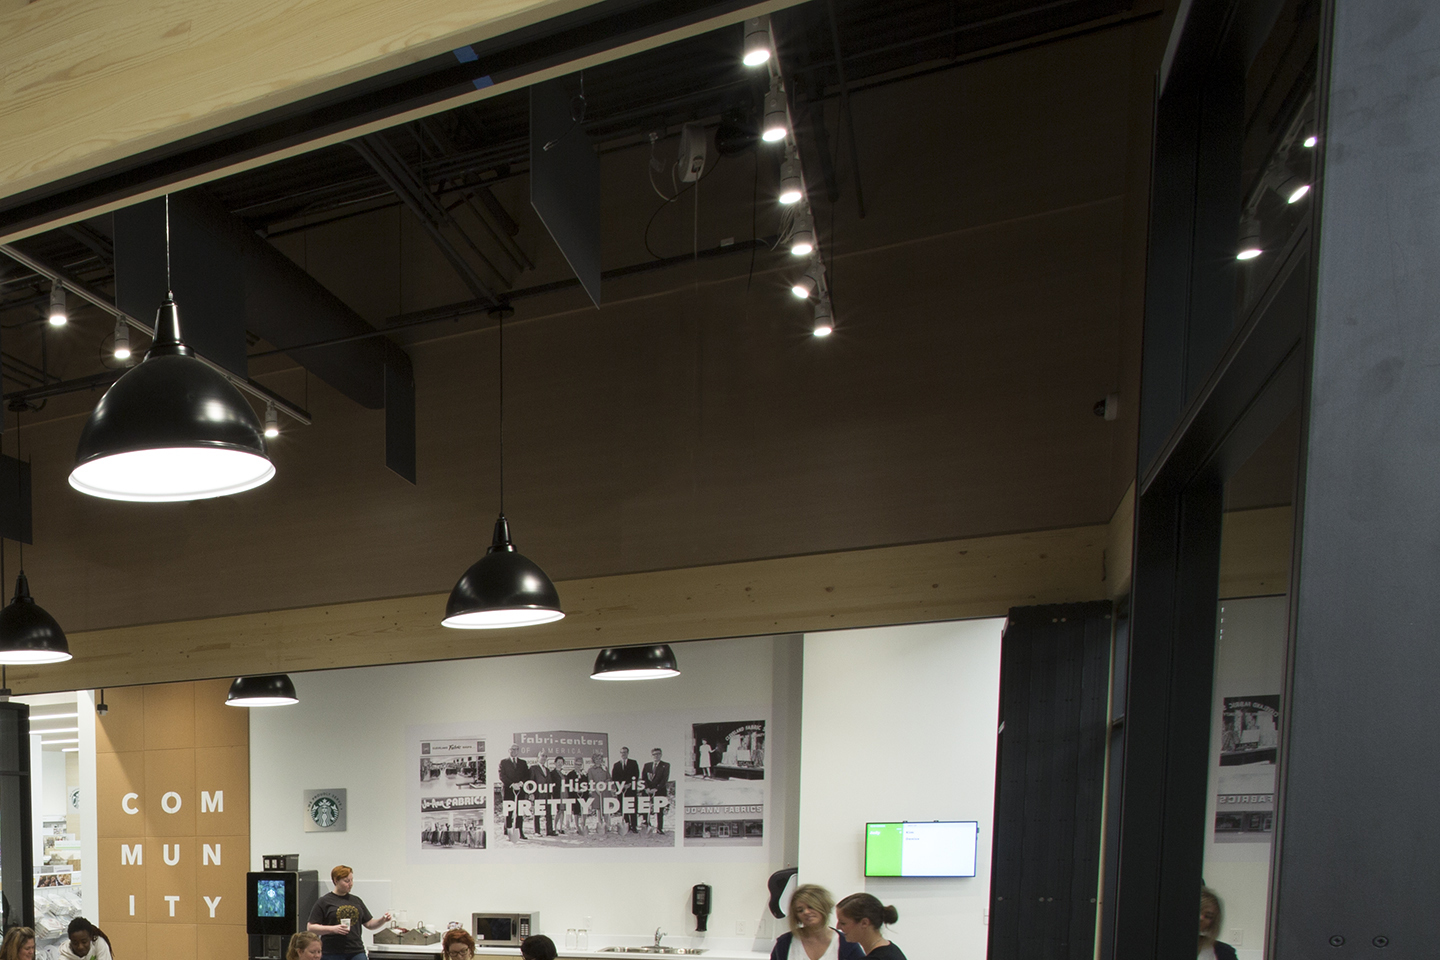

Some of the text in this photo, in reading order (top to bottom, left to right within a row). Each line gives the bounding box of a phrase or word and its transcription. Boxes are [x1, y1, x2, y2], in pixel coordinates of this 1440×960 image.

[521, 733, 604, 746] Fabri-centers
[523, 776, 646, 795] Our History is
[444, 796, 485, 809] FABRICS
[503, 796, 671, 817] PRETTY DEEP
[724, 805, 762, 813] FABRICS
